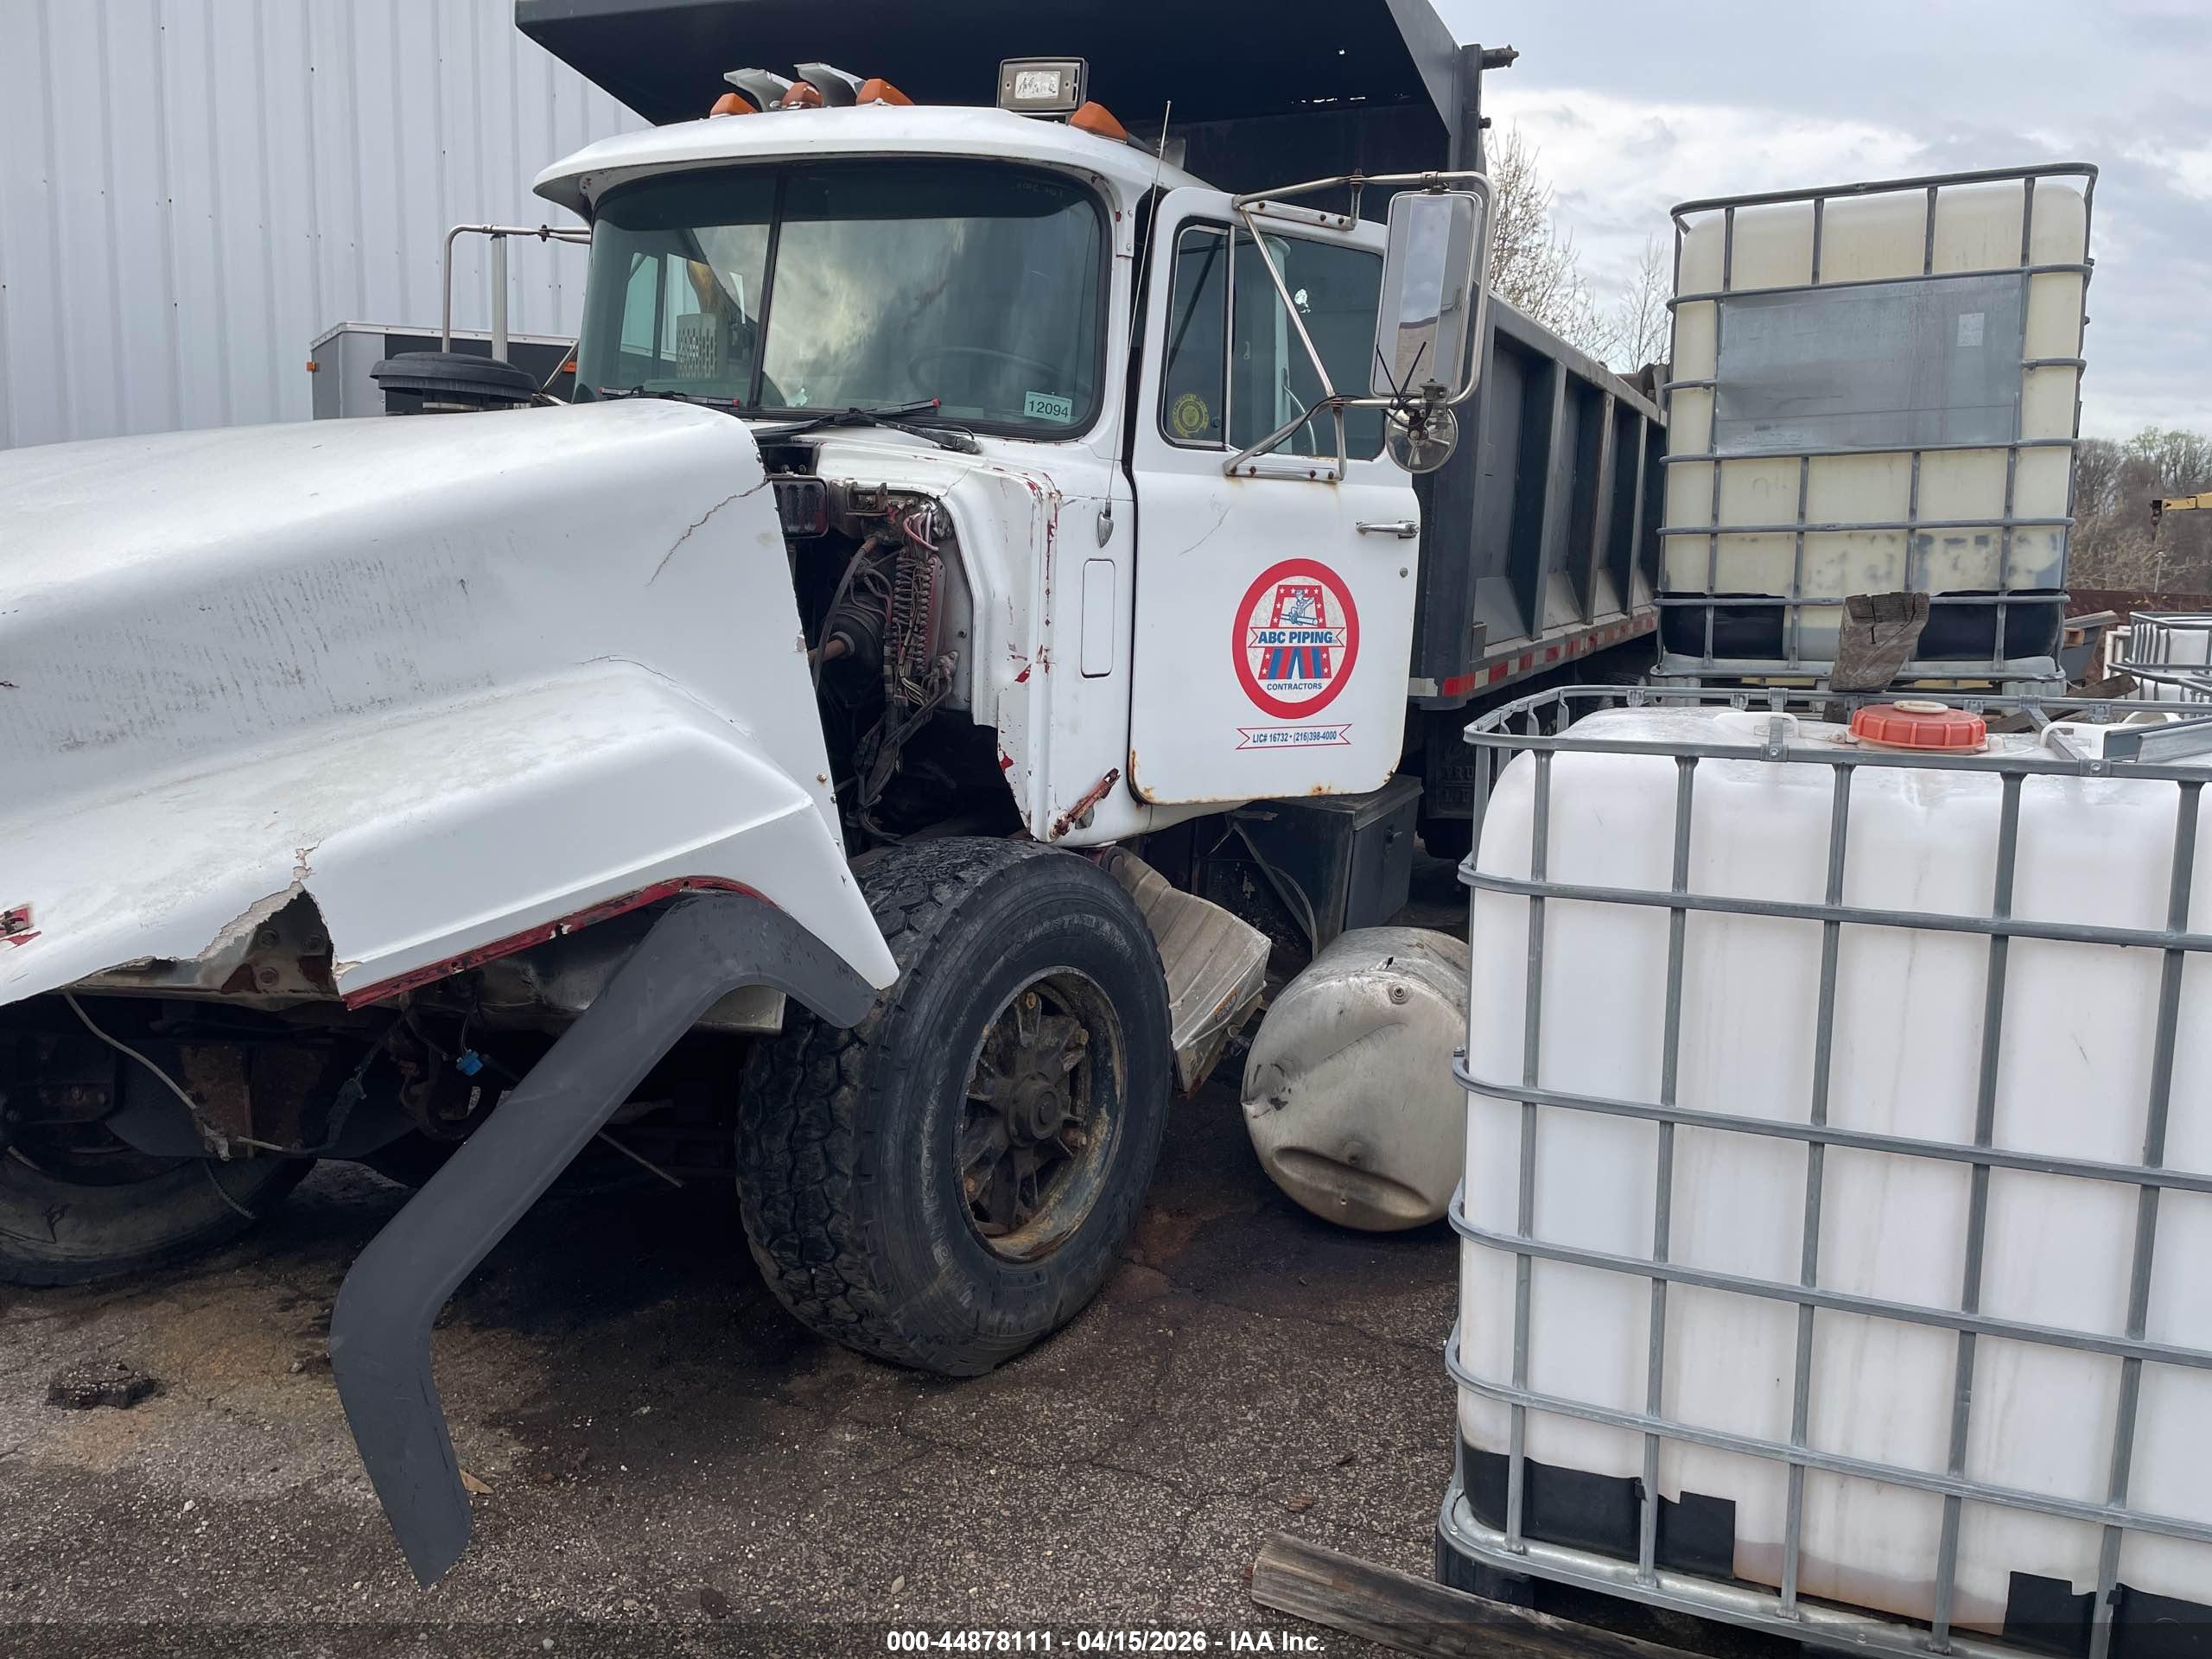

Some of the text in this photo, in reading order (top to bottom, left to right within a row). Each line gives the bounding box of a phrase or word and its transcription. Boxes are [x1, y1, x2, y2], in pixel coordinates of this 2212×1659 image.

[1029, 400, 1069, 417] 12094
[1258, 631, 1333, 644] ABC PIPING
[1253, 734, 1268, 743] LIC#
[1269, 733, 1288, 742] 16732
